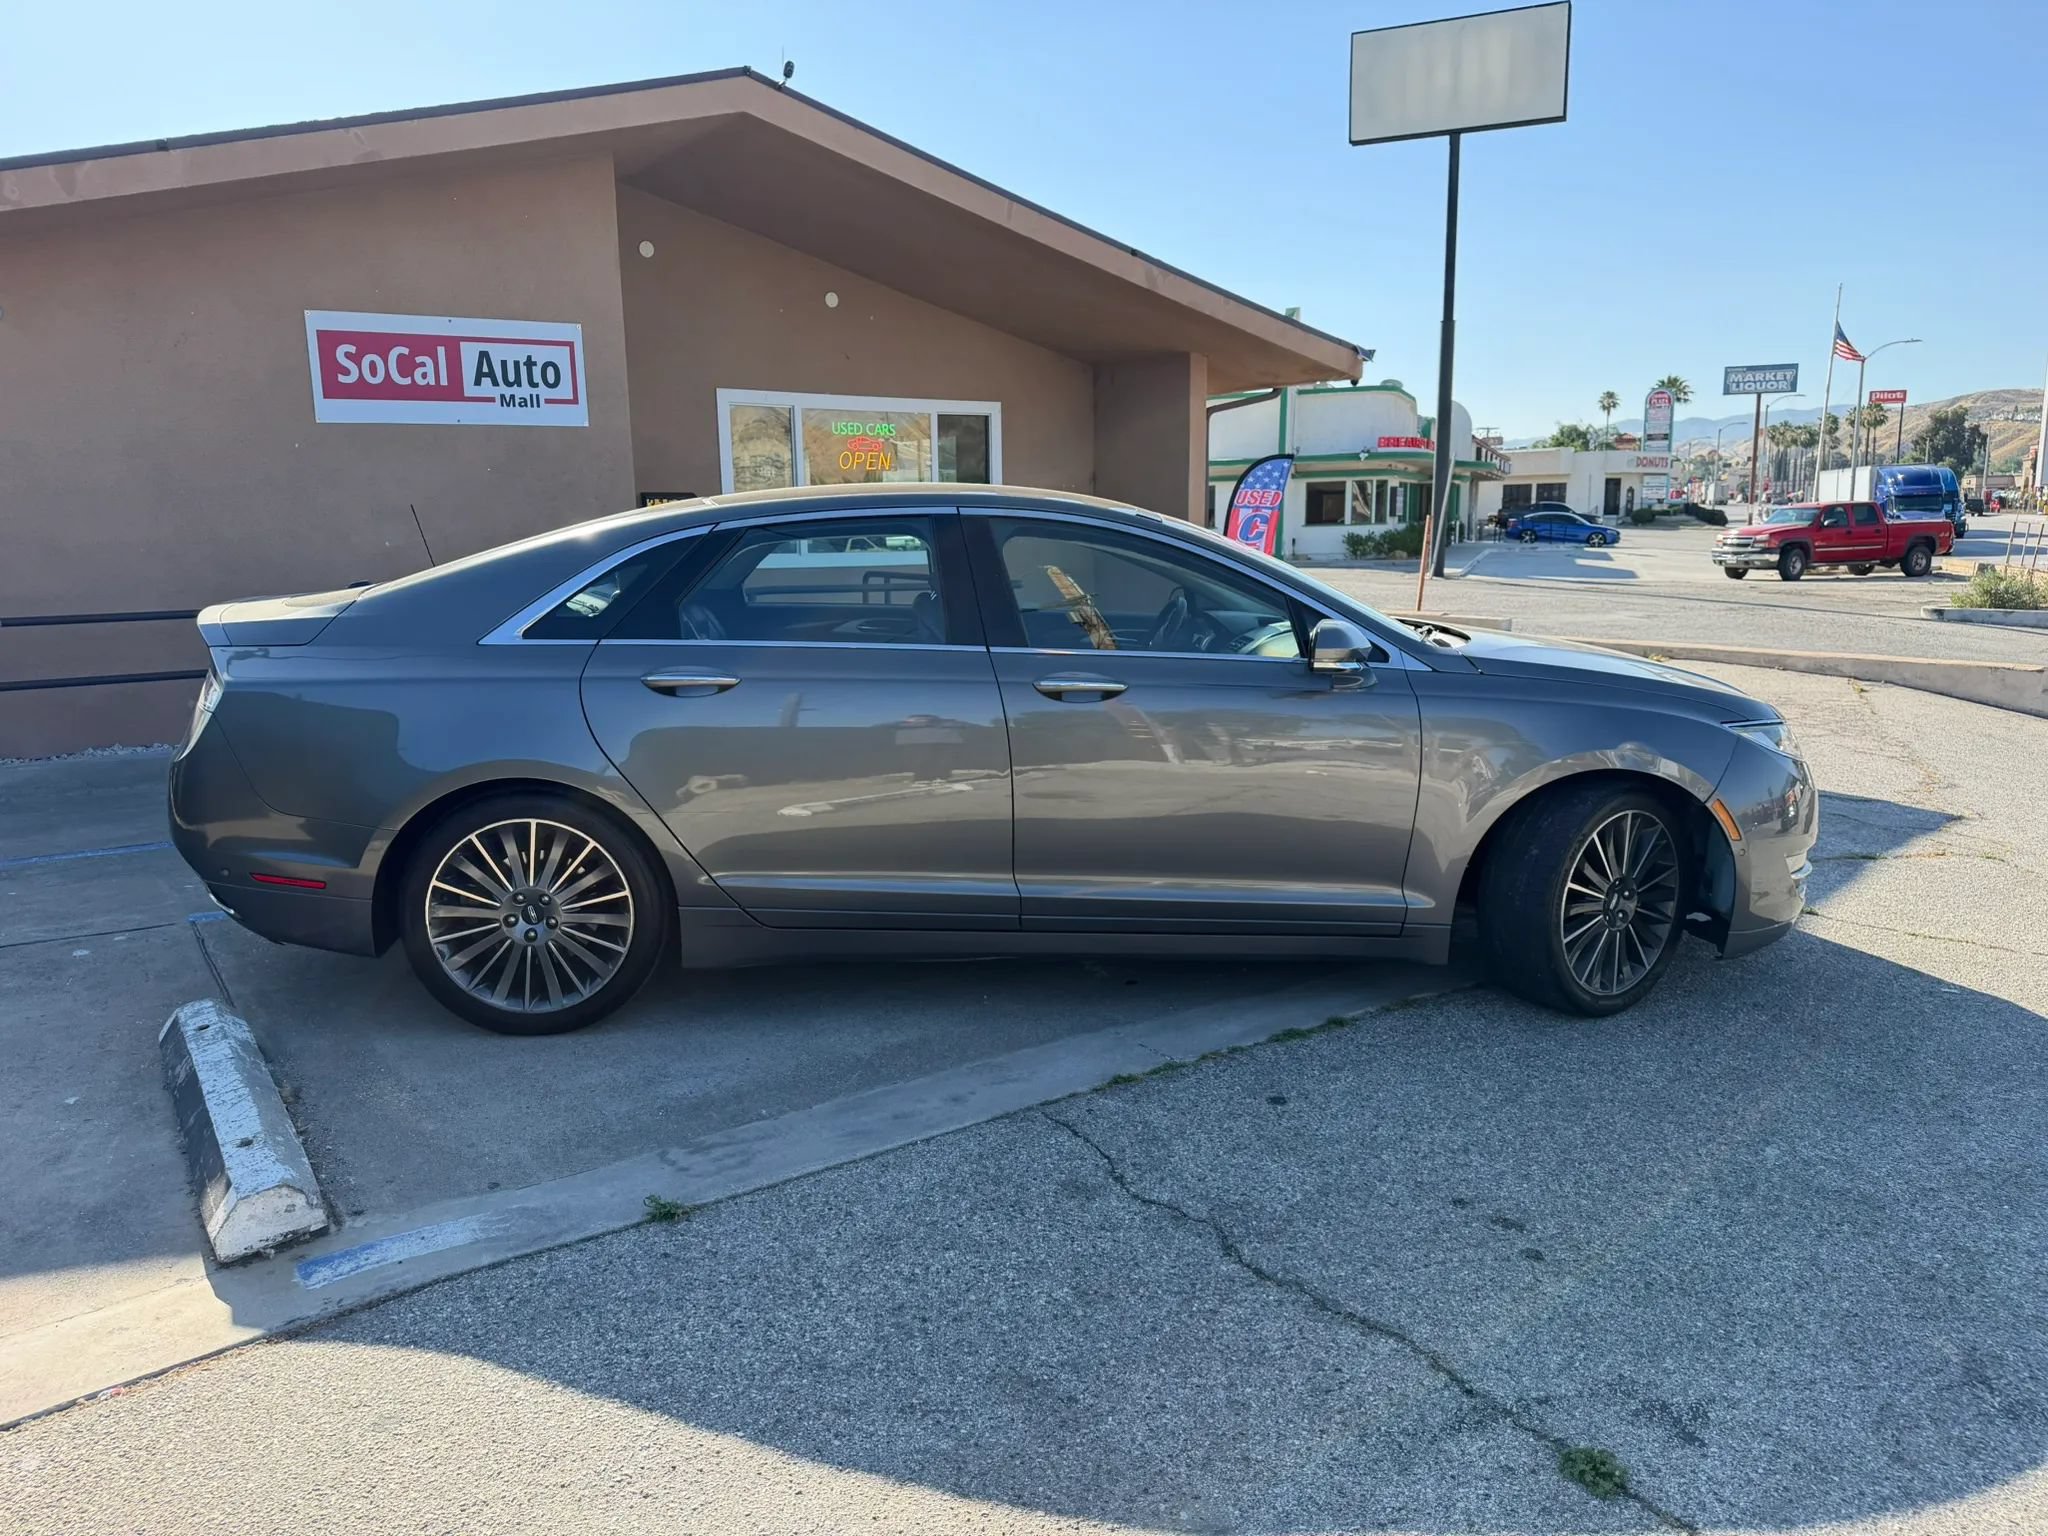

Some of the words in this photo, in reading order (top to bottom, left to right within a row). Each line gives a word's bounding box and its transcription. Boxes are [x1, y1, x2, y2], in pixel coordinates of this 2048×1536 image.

[336, 344, 448, 386] SoCal
[473, 350, 561, 389] Auto
[1729, 371, 1793, 383] MARKET
[1731, 380, 1788, 391] LIQUOR
[499, 393, 541, 408] Mall
[832, 421, 863, 436] USED
[866, 423, 897, 437] CARS
[839, 451, 891, 470] OPEN
[1636, 456, 1669, 468] DONUTS
[1234, 489, 1283, 507] USED
